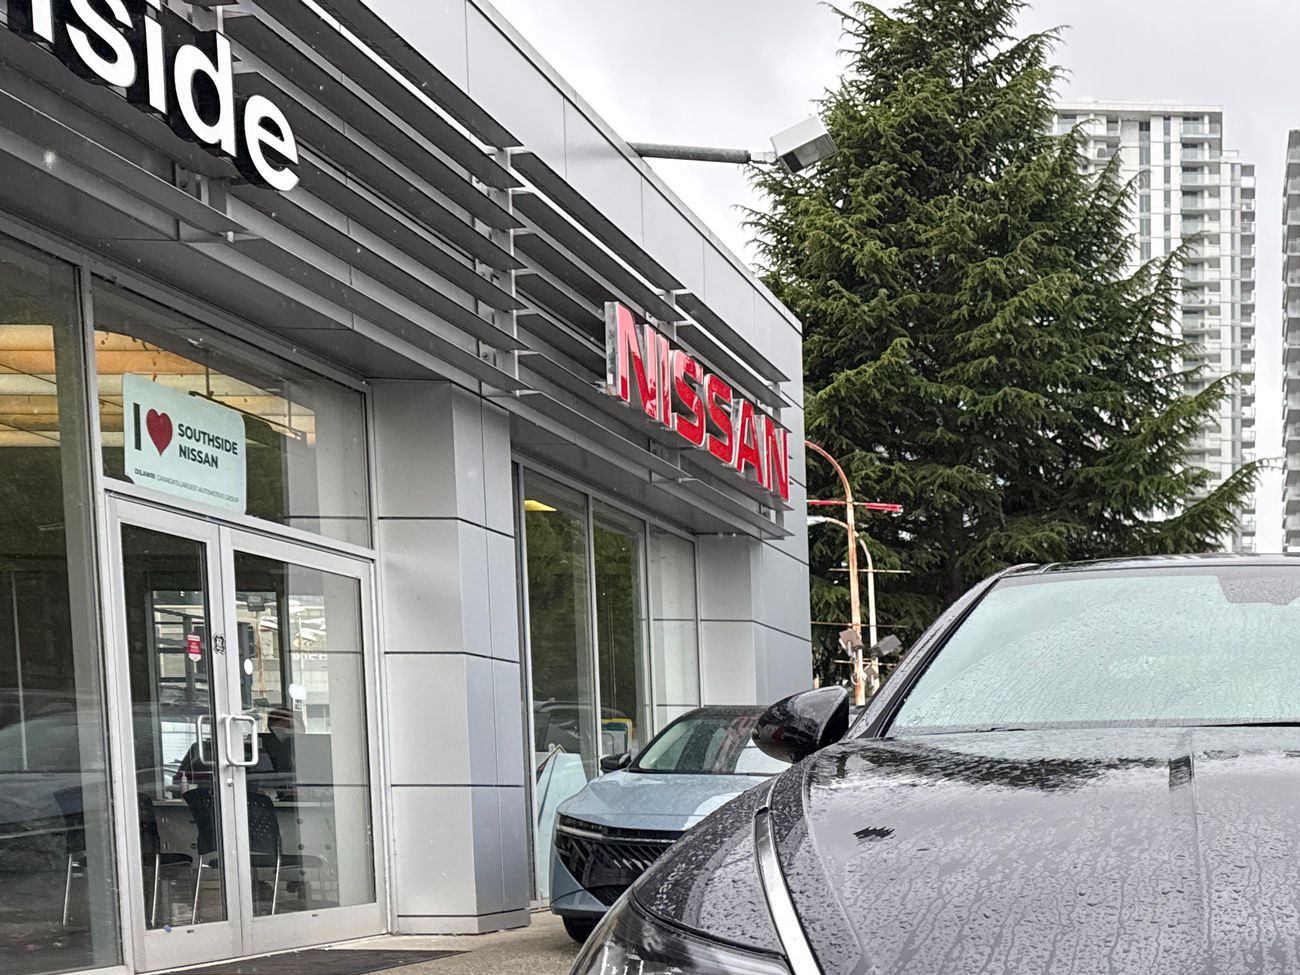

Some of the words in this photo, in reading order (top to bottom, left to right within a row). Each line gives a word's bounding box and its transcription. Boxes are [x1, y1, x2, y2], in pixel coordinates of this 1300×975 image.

[32, 0, 299, 191] side
[611, 301, 789, 502] NISSAN
[133, 402, 142, 451] I
[178, 423, 239, 455] SOUTHSIDE
[179, 443, 219, 469] NISSAN
